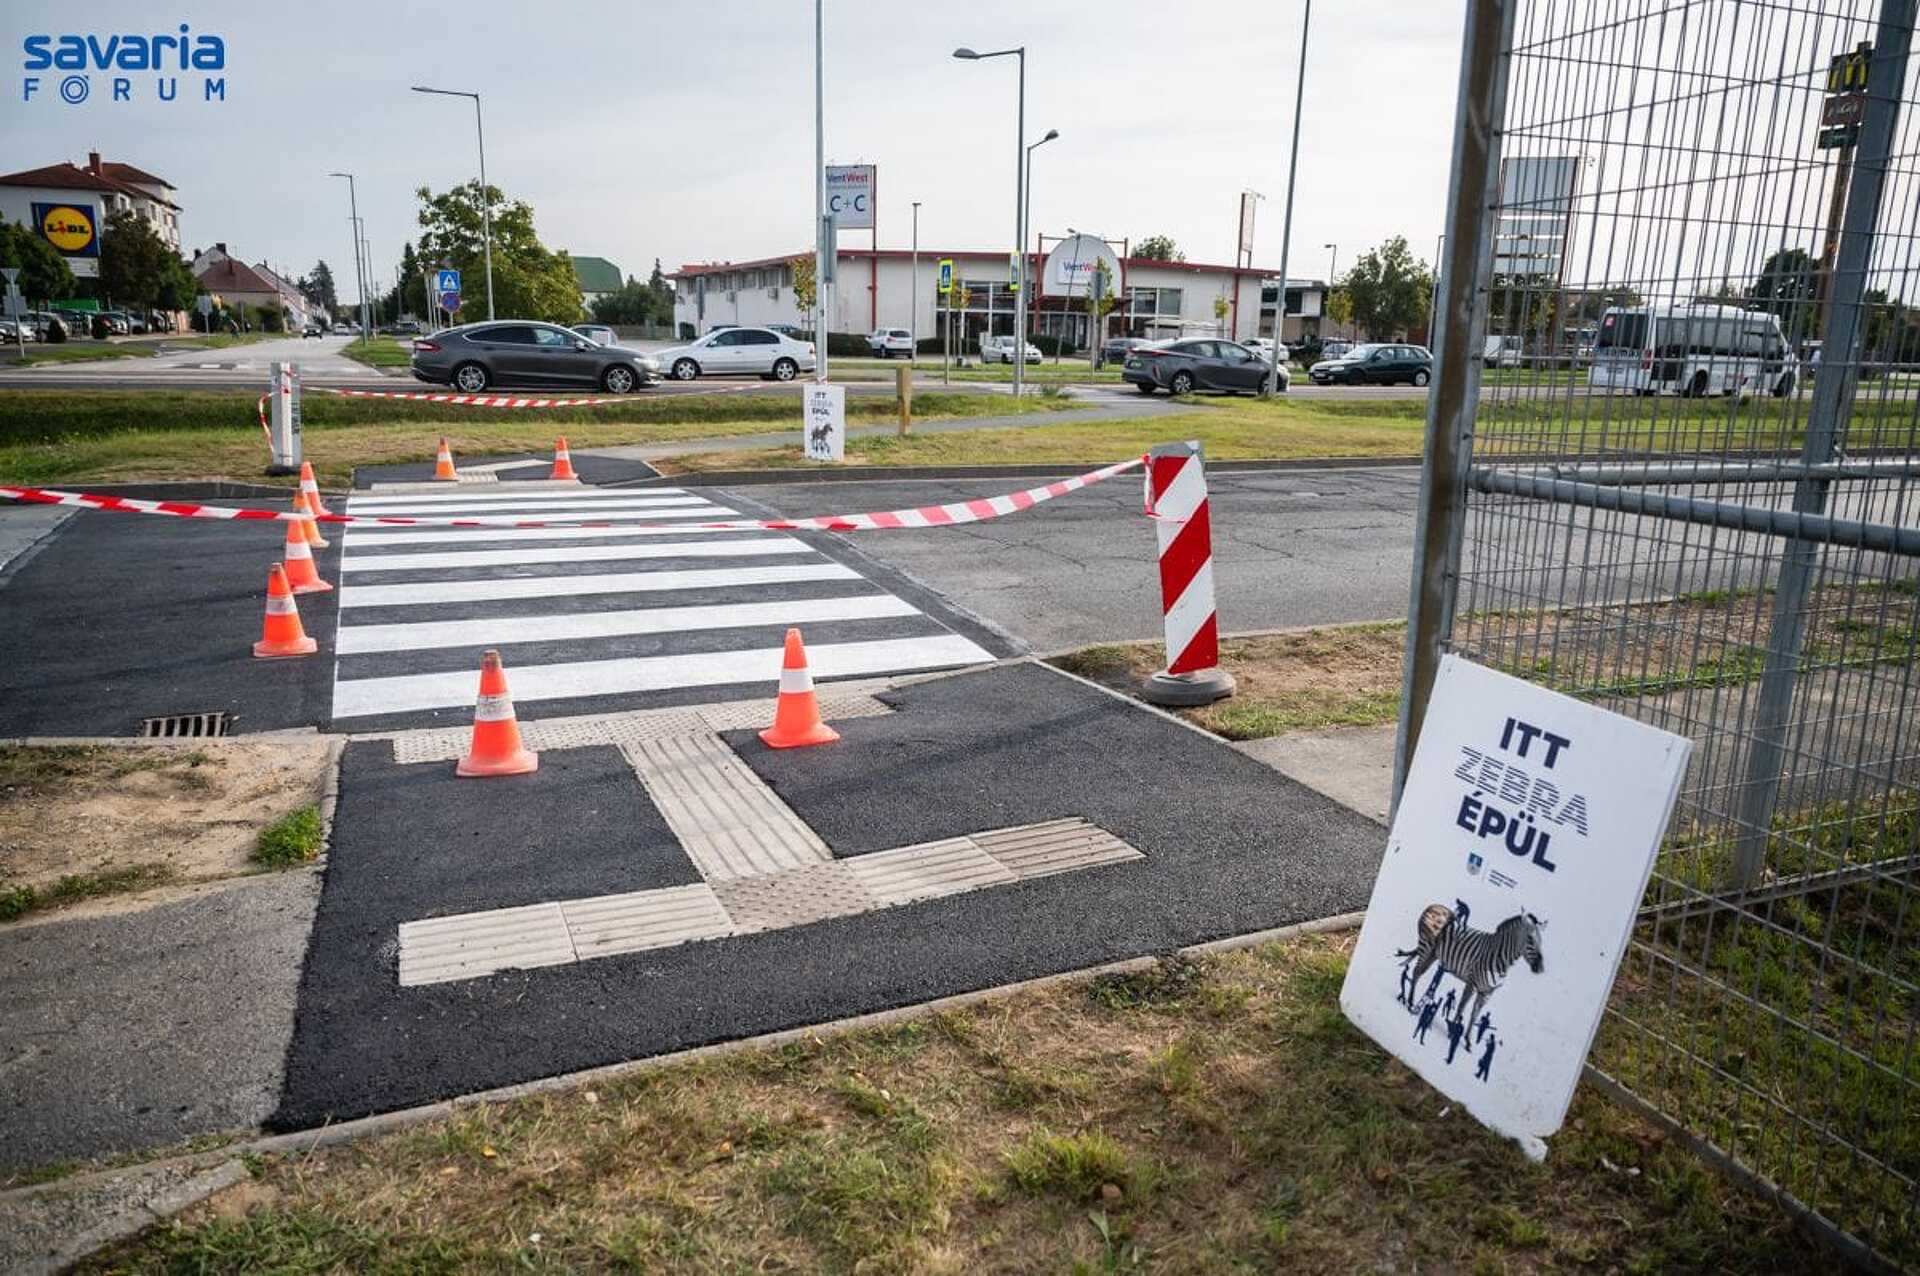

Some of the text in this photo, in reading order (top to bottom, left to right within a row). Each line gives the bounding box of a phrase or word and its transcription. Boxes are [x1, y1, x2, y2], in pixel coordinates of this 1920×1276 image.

[1499, 717, 1571, 770] ITT
[1454, 746, 1588, 837] ZEBRA
[1456, 790, 1557, 873] ÉPÜL
